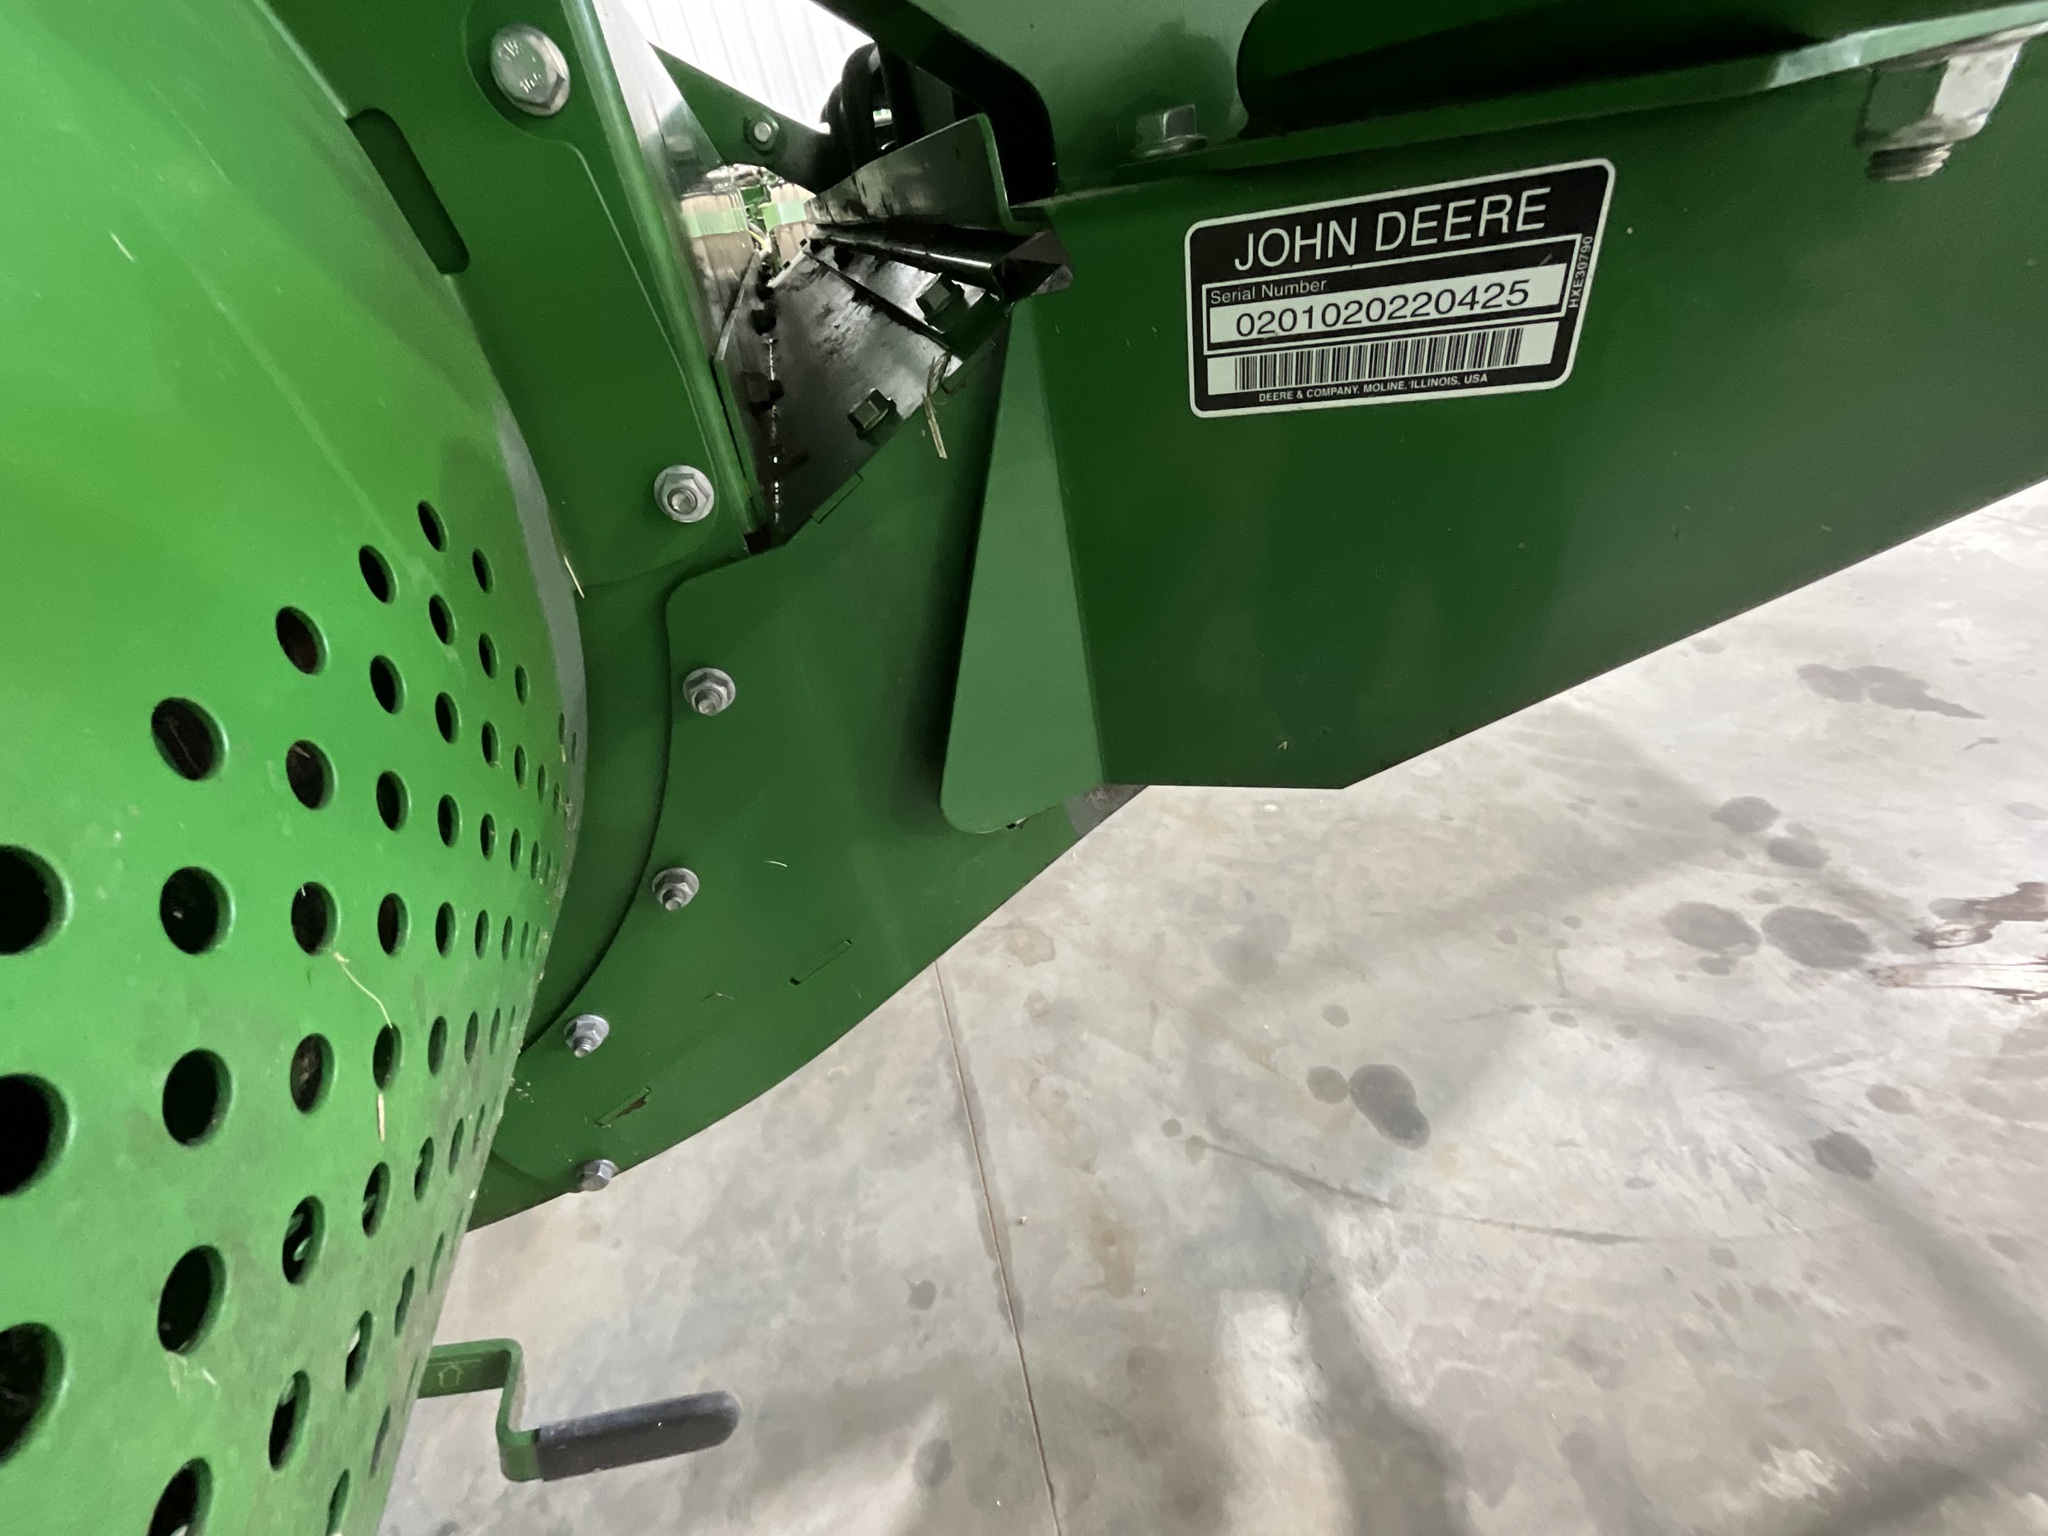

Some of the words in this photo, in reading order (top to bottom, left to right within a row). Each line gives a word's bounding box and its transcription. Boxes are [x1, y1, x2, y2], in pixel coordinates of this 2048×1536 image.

[1234, 217, 1358, 271] JOHN
[1375, 187, 1551, 252] DEERE
[1210, 286, 1256, 305] Serial
[1261, 279, 1328, 299] Number
[1568, 235, 1594, 308] HXE30790
[1235, 279, 1531, 337] 0201020220425
[1258, 390, 1294, 402] DEERE
[1296, 388, 1304, 399] &
[1464, 373, 1489, 385] USA
